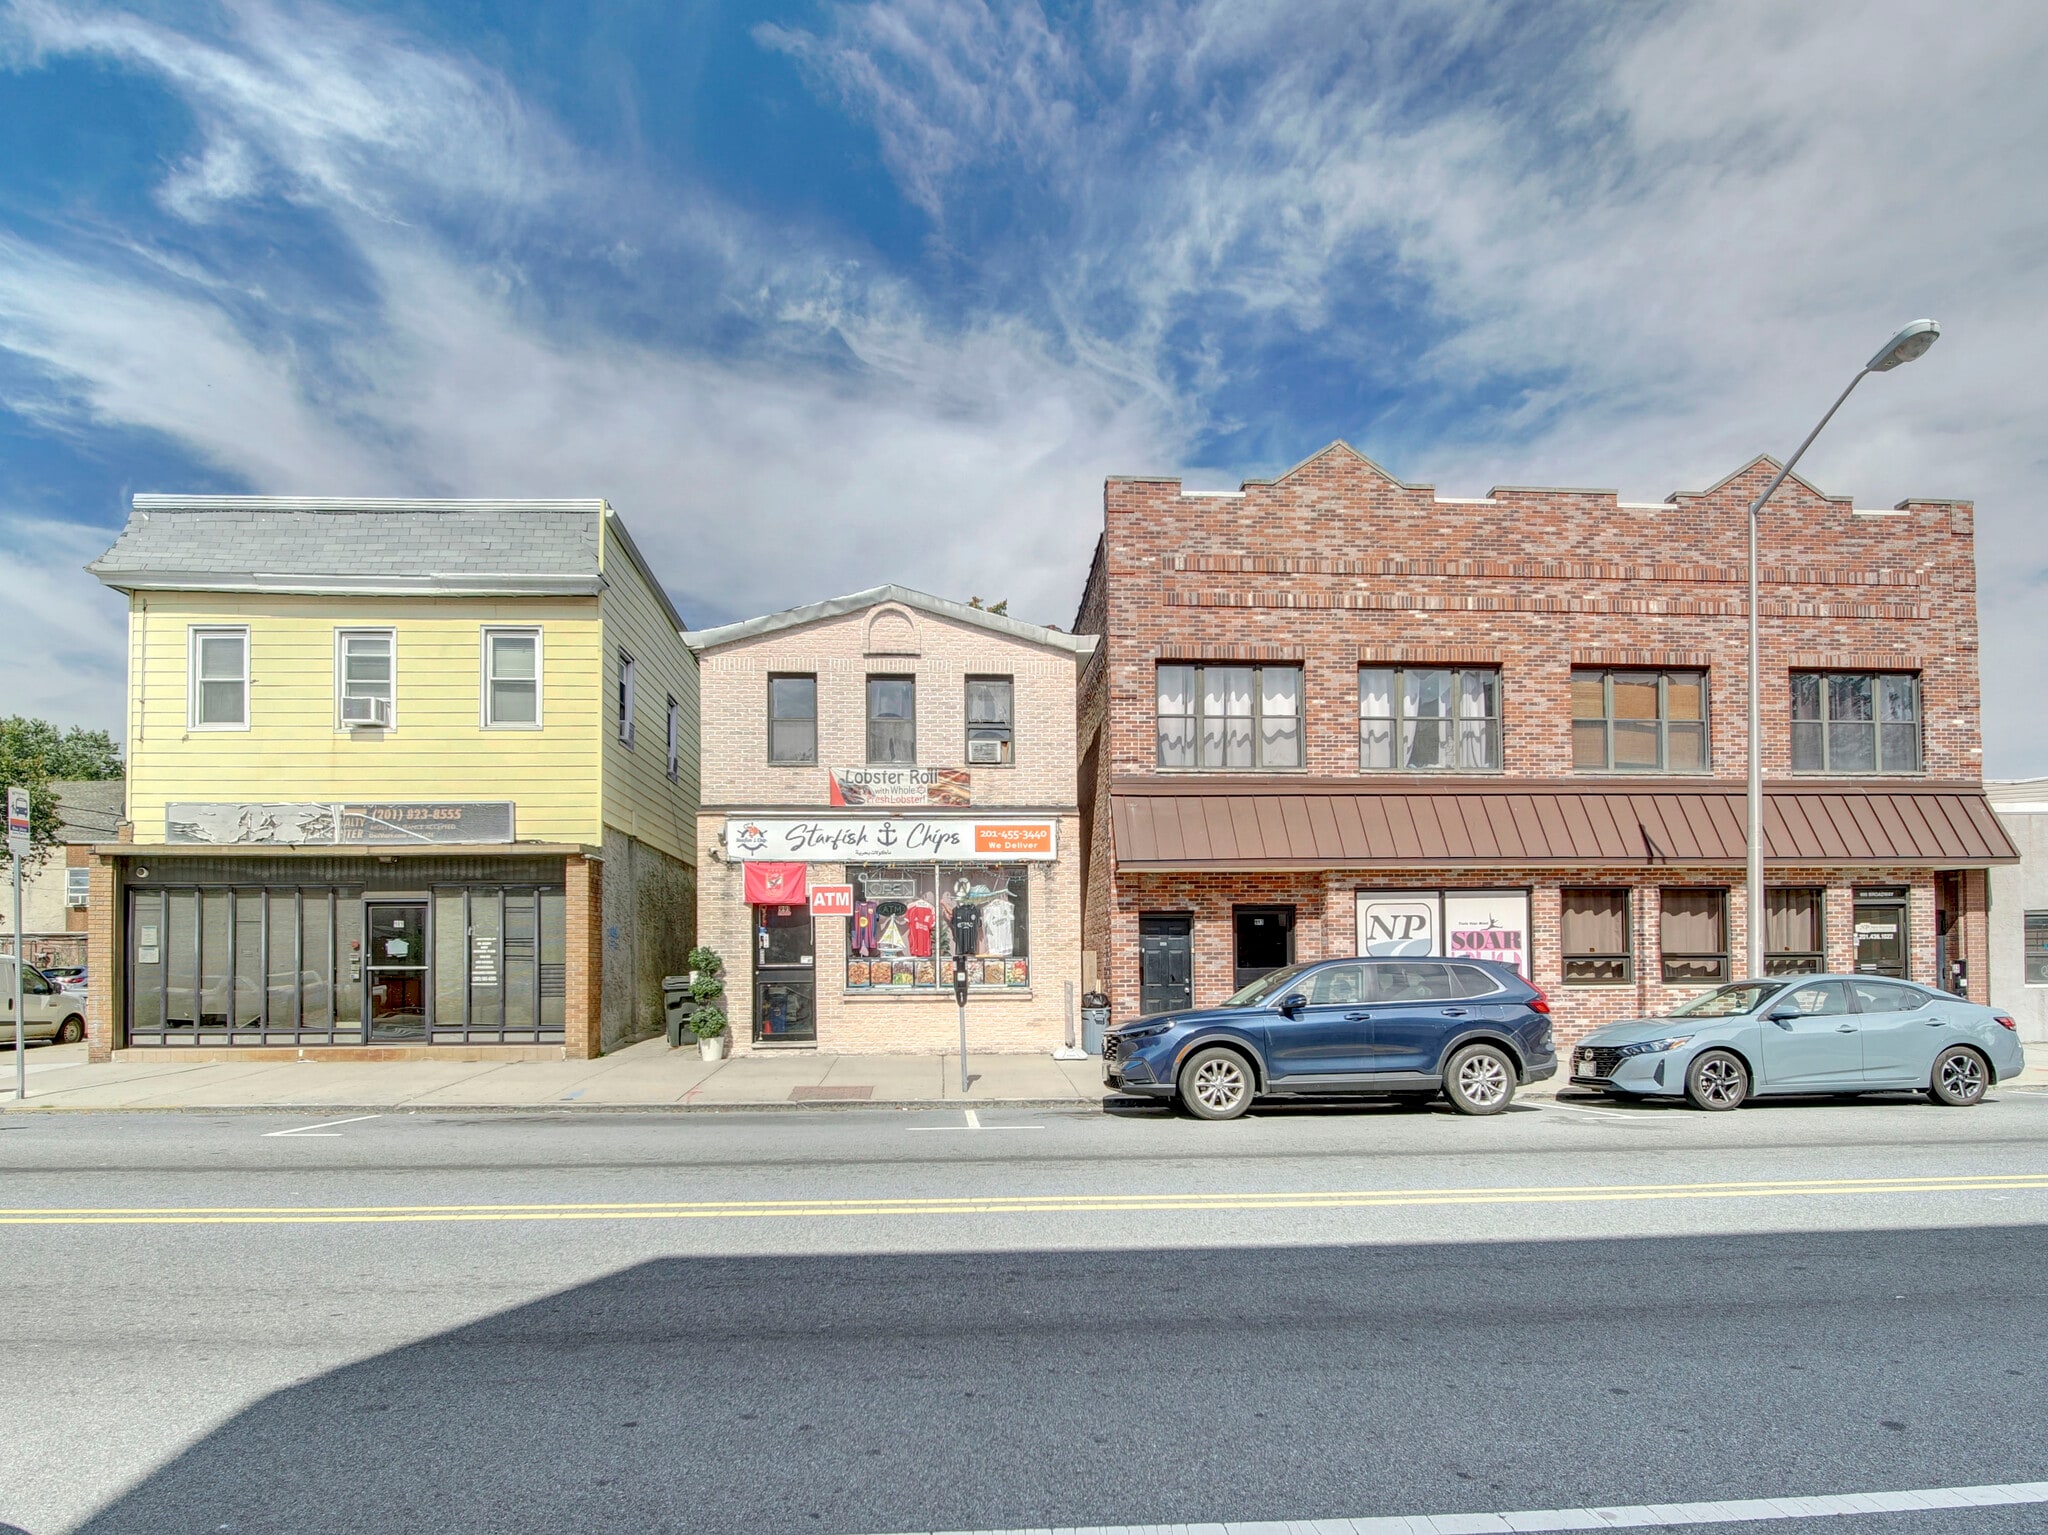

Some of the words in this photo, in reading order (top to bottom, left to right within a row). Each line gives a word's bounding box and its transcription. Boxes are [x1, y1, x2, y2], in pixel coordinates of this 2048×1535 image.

[845, 769, 903, 784] Lobster
[910, 769, 938, 784] Roll
[875, 787, 889, 795] with
[891, 786, 916, 795] Whole
[866, 795, 890, 804] Fresh
[371, 808, 403, 823] (201)
[785, 823, 868, 851] Starfish
[906, 823, 960, 854] Chips
[980, 830, 1047, 840] 201-455-3440
[988, 841, 1002, 849] We
[1005, 841, 1038, 849] Deliver
[870, 882, 913, 896] OPEN
[813, 892, 849, 906] ATM
[1366, 914, 1427, 940] NP
[1451, 931, 1522, 950] SOAR
